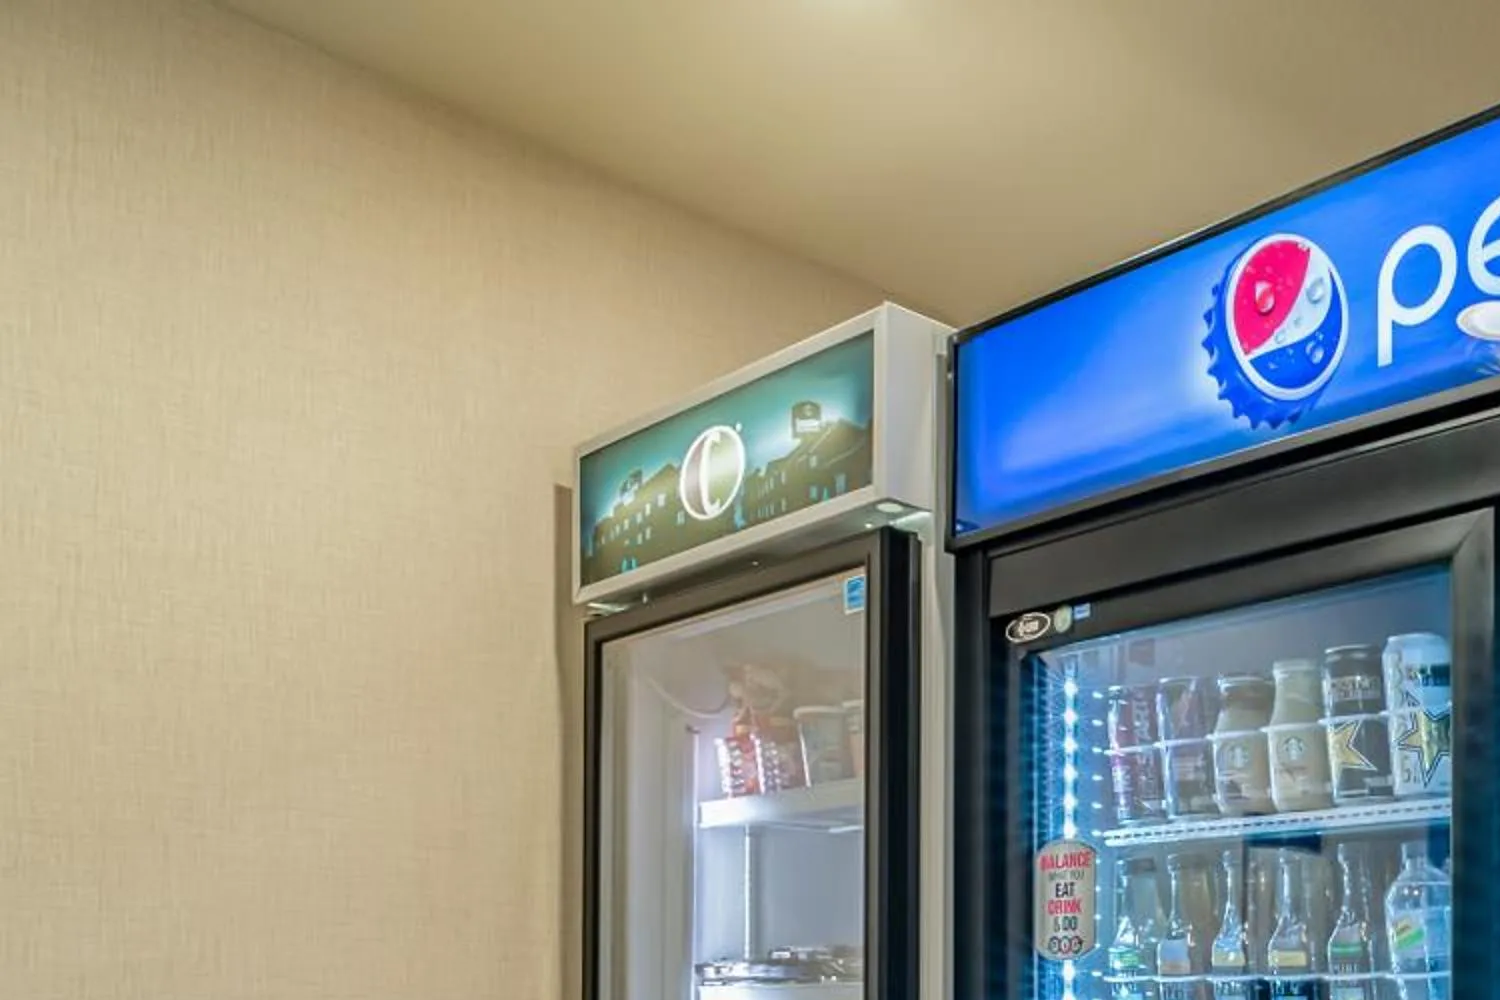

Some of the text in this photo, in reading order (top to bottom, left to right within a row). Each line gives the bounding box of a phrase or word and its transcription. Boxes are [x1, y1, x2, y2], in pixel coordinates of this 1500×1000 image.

[1040, 848, 1091, 871] BALANCE
[1055, 882, 1074, 898] EAT
[1047, 899, 1082, 915] DRINK
